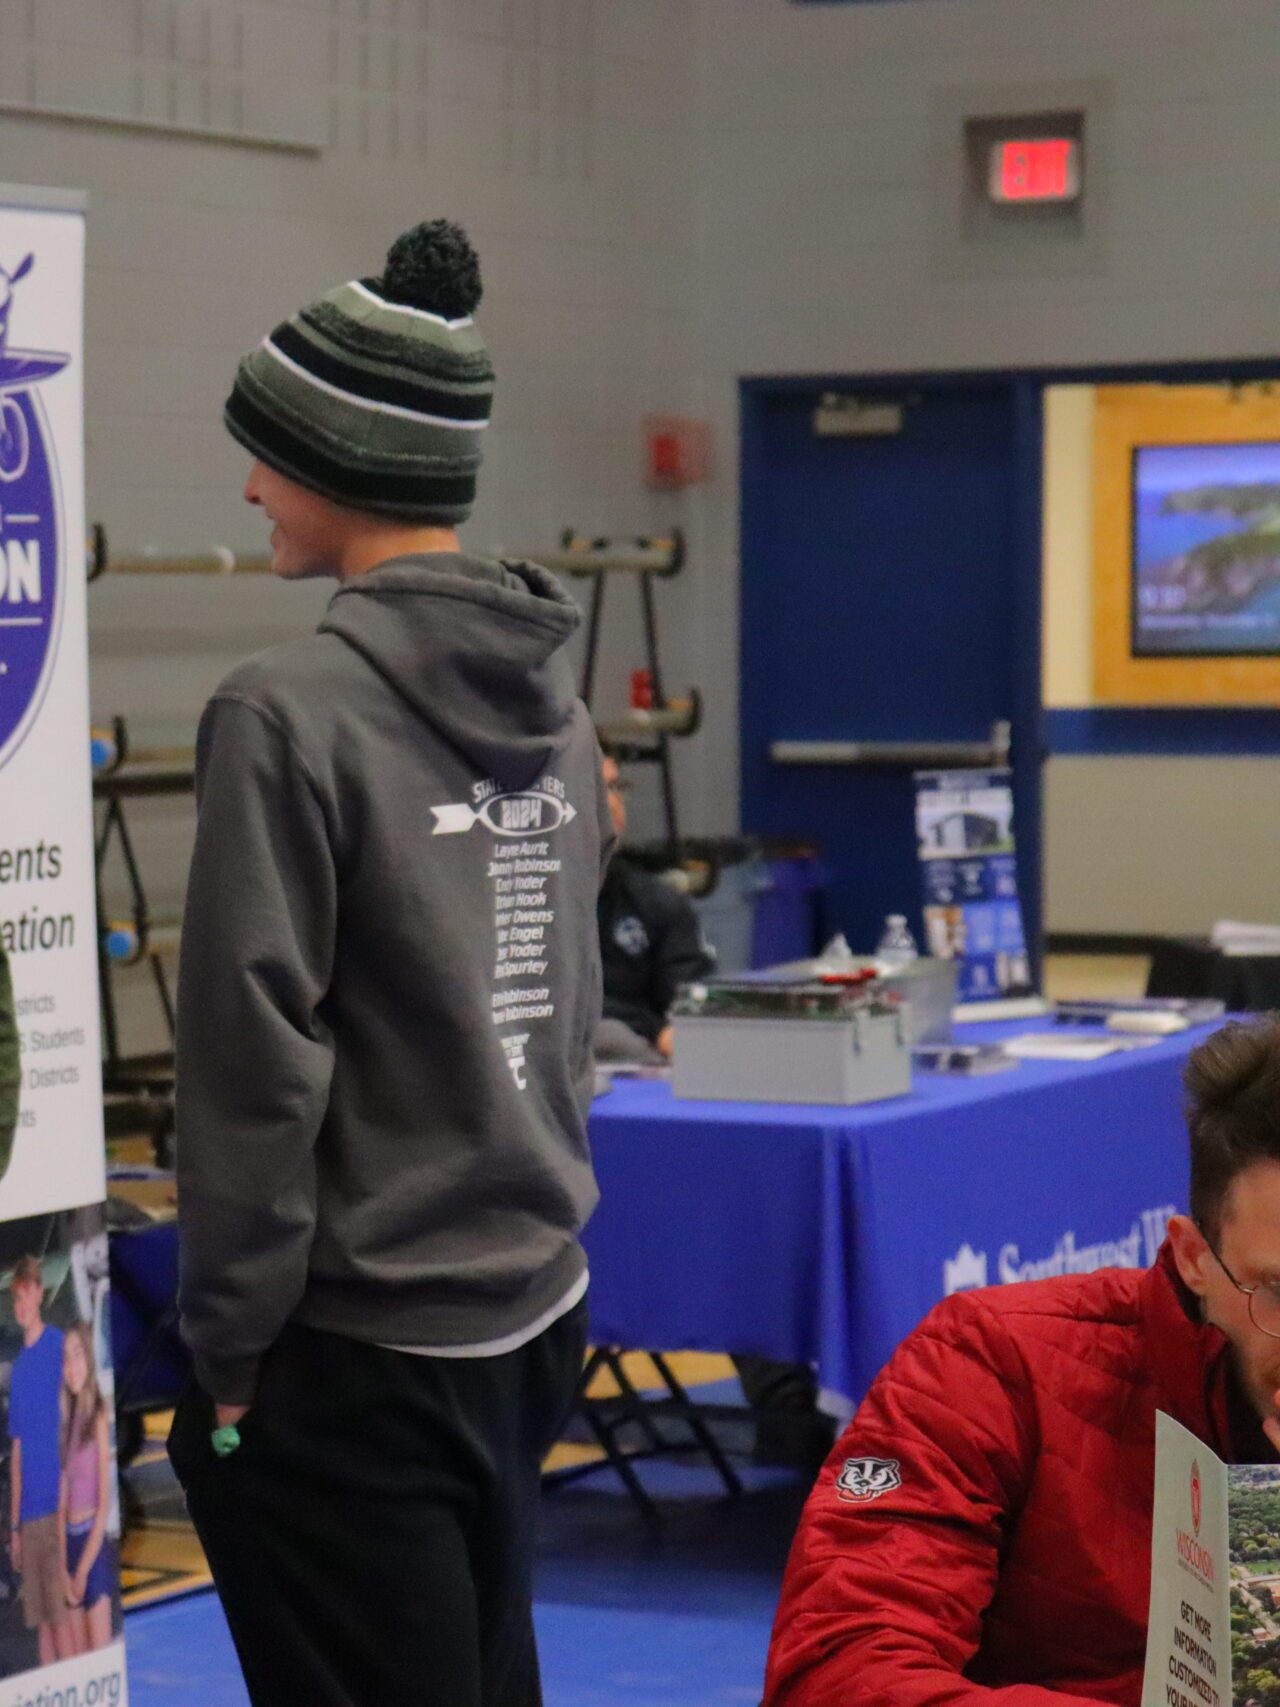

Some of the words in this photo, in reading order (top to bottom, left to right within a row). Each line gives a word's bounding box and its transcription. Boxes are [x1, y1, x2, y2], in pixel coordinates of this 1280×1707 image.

[501, 799, 542, 829] 2024
[515, 891, 548, 907] Hook
[512, 909, 555, 924] Owens
[3, 906, 75, 953] ation
[509, 926, 545, 943] Engel
[509, 943, 548, 958] Yoder
[17, 995, 55, 1016] stricts
[30, 1027, 86, 1052] Students
[30, 1066, 80, 1090] Districts
[1176, 1528, 1216, 1582] WISCONSIN
[1181, 1600, 1194, 1625] GET
[1195, 1610, 1212, 1643] MORE
[1174, 1625, 1217, 1680] INFORMATION
[1169, 1655, 1211, 1705] CUSTOMIZED
